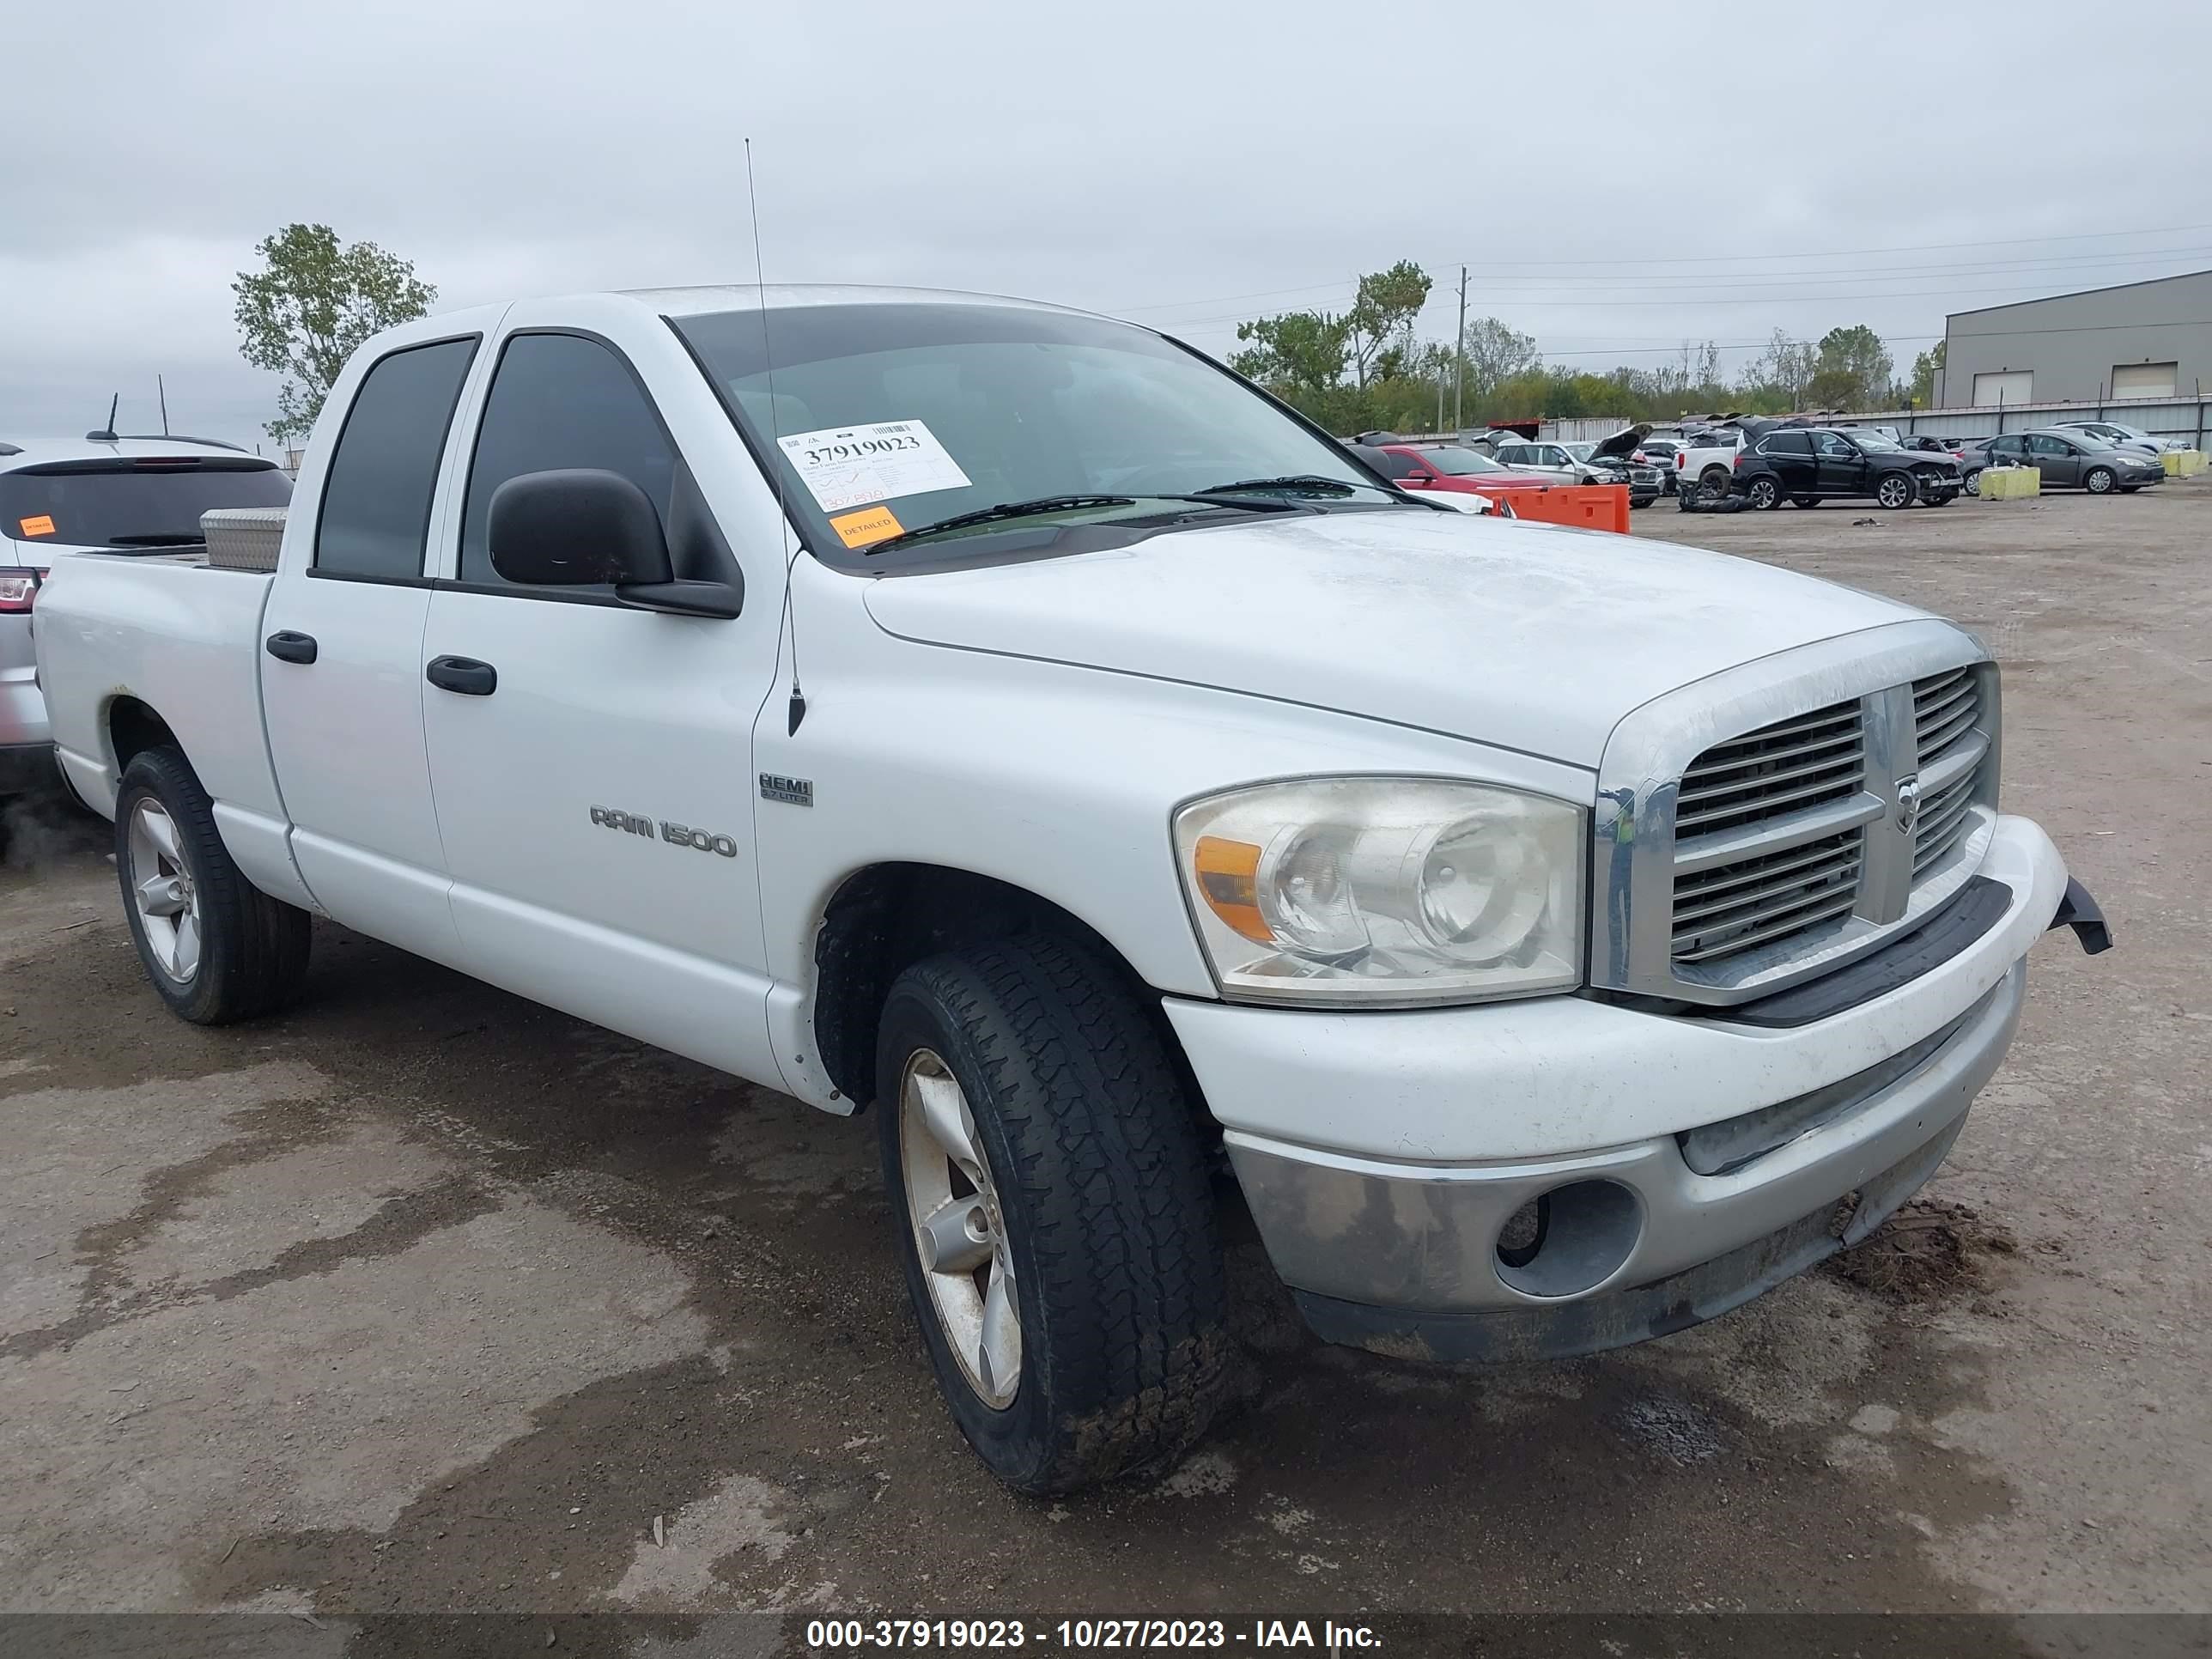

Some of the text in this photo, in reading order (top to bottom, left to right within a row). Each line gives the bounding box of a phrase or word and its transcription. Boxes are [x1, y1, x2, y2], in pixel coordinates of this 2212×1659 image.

[804, 435, 921, 465] 37919023
[843, 518, 891, 536] DETAILED
[759, 772, 811, 794] HEMI
[779, 792, 809, 804] LITER
[589, 804, 738, 858] RAM 1500
